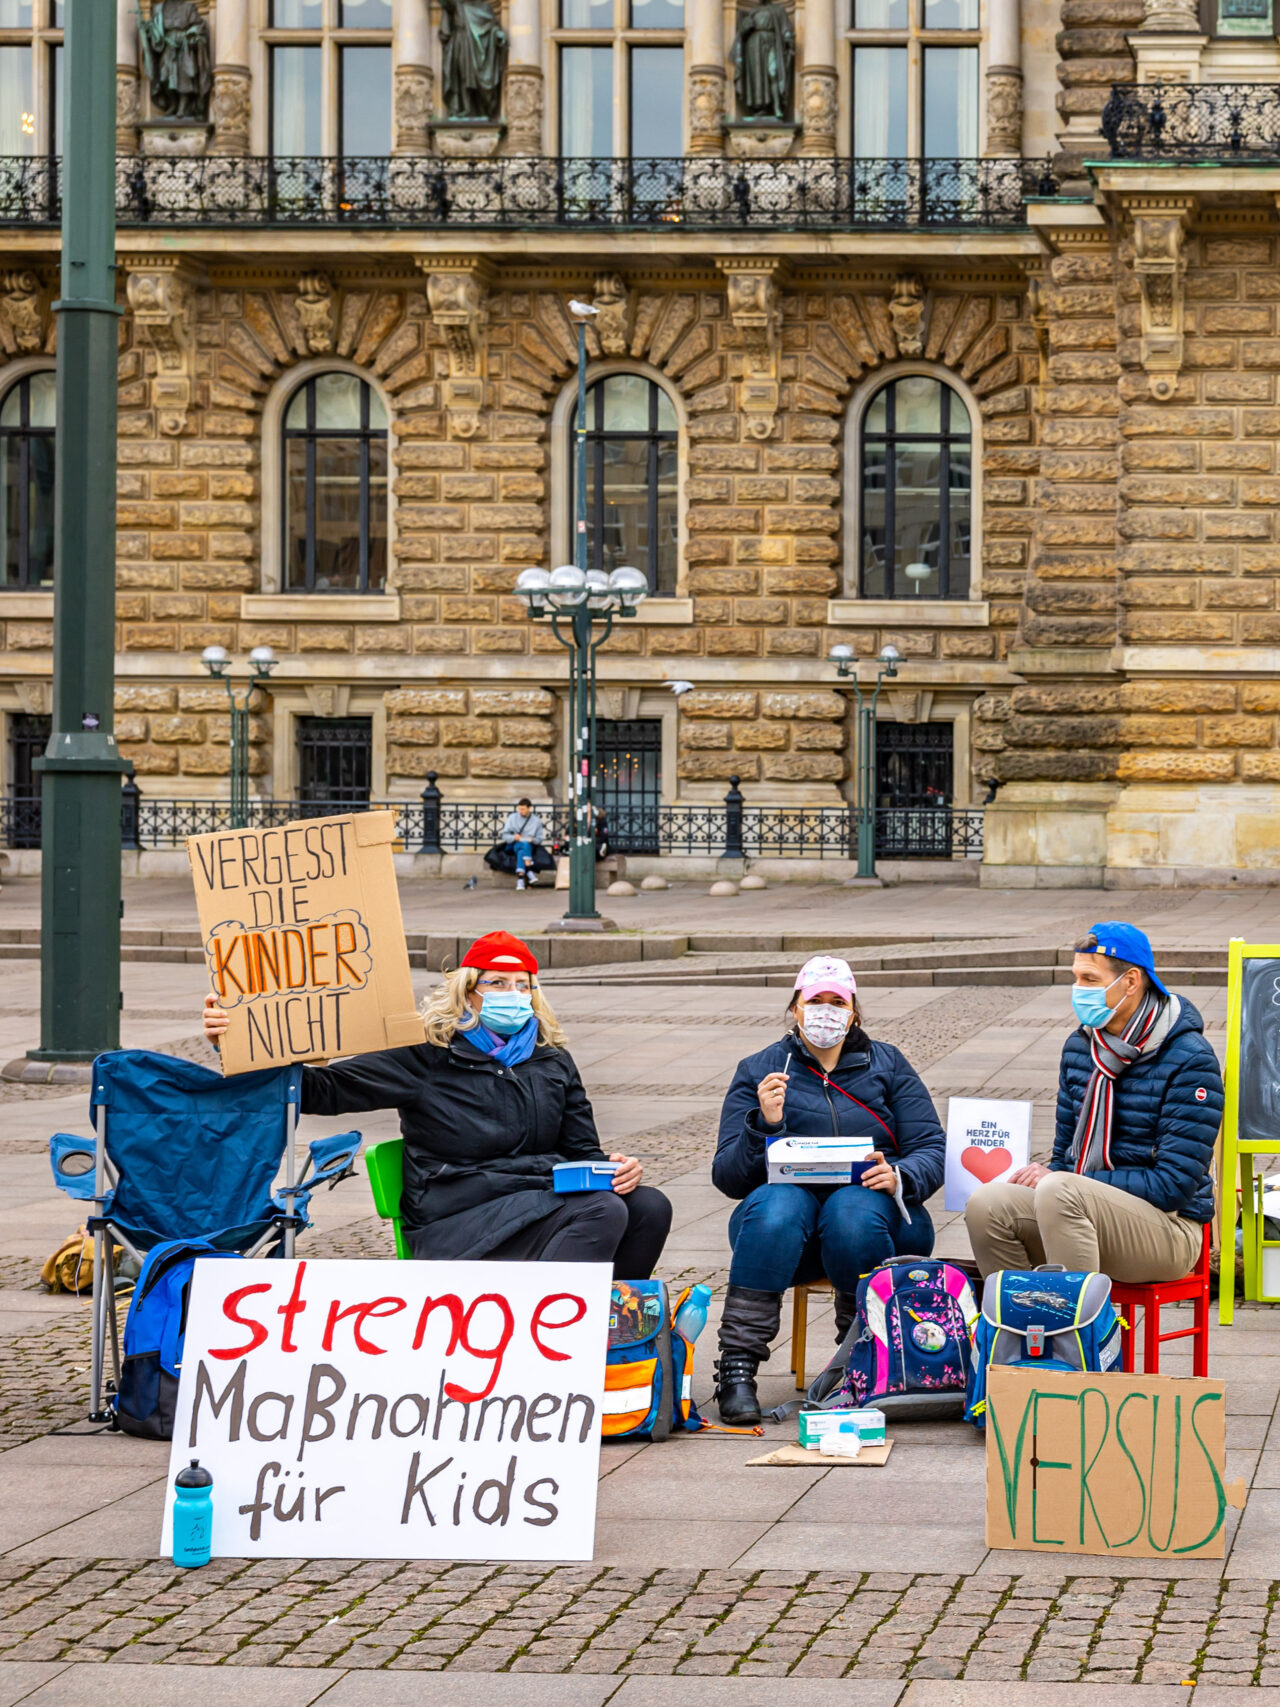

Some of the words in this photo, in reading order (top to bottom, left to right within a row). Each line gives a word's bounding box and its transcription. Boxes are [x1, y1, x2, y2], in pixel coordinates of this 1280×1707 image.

[196, 822, 351, 891] VERGESST
[248, 885, 309, 929] DIE
[213, 922, 363, 998] KINDER
[247, 992, 350, 1062] NICHT
[966, 1129, 990, 1138] HERZ
[992, 1129, 1010, 1139] FÜR
[971, 1138, 1005, 1147] KINDER
[981, 1121, 997, 1129] EIN
[238, 1461, 346, 1542] für
[400, 1450, 560, 1527] Kids
[988, 1388, 1226, 1554] VERSUS
